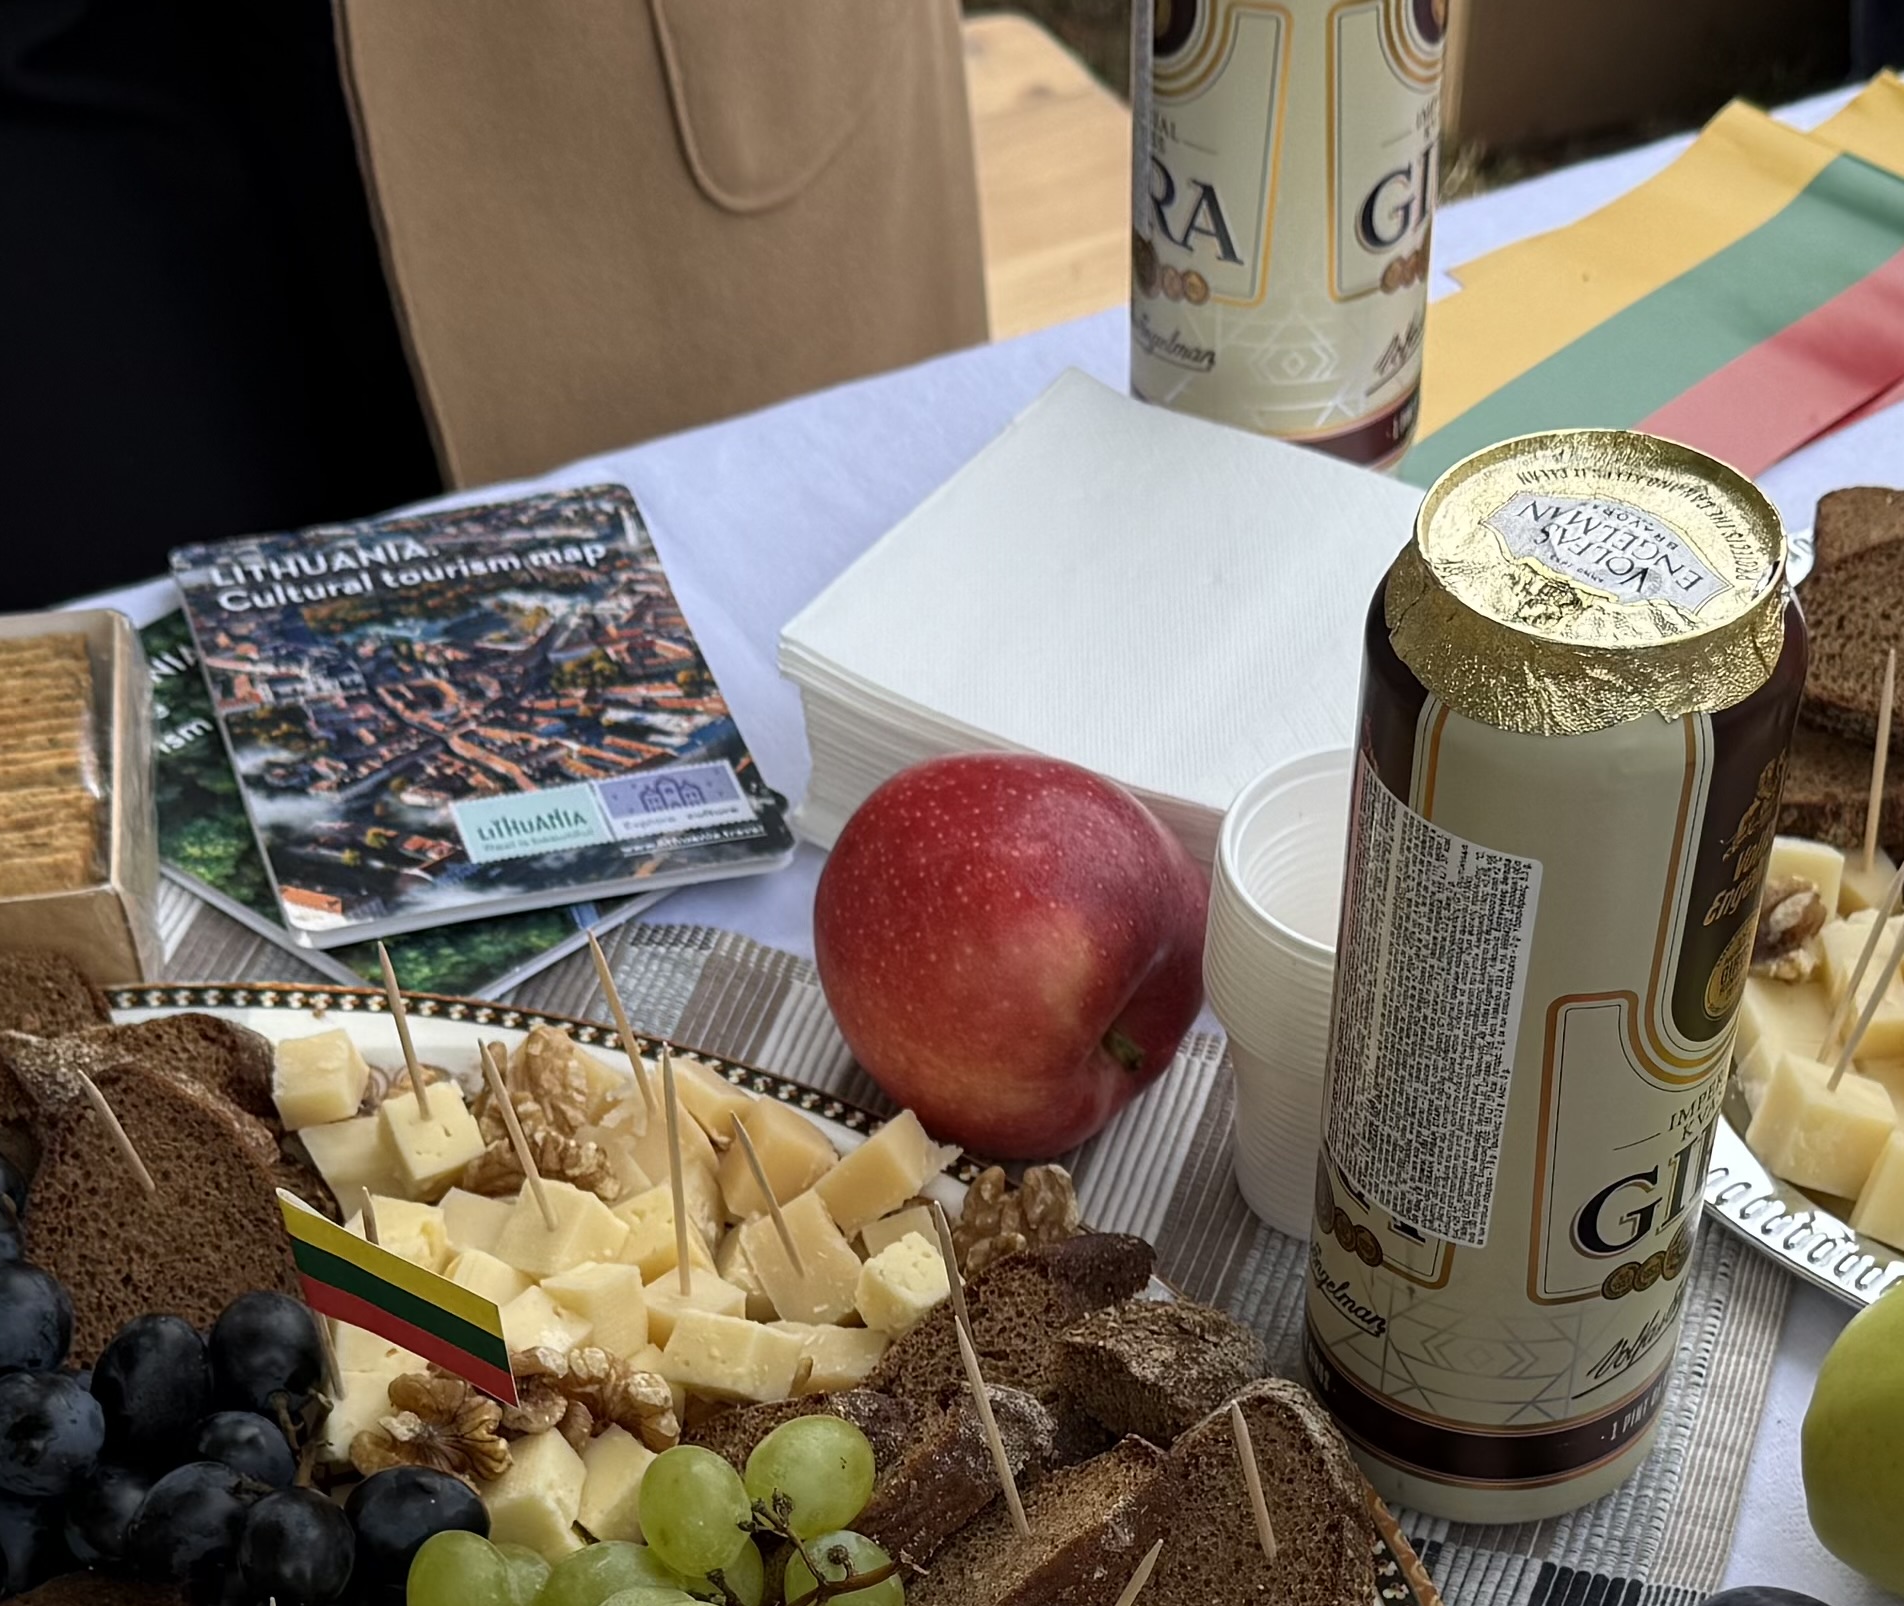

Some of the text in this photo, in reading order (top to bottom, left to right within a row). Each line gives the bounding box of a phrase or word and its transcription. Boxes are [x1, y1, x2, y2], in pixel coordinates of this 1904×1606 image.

[1149, 156, 1244, 264] RA
[1356, 144, 1439, 253] GI
[210, 535, 439, 590] LITHUANIA.
[218, 540, 608, 614] Cultural tourism map
[1517, 499, 1705, 593] ENGELMAN
[1534, 521, 1652, 594] VOLFAS
[1570, 1132, 1712, 1260] GI
